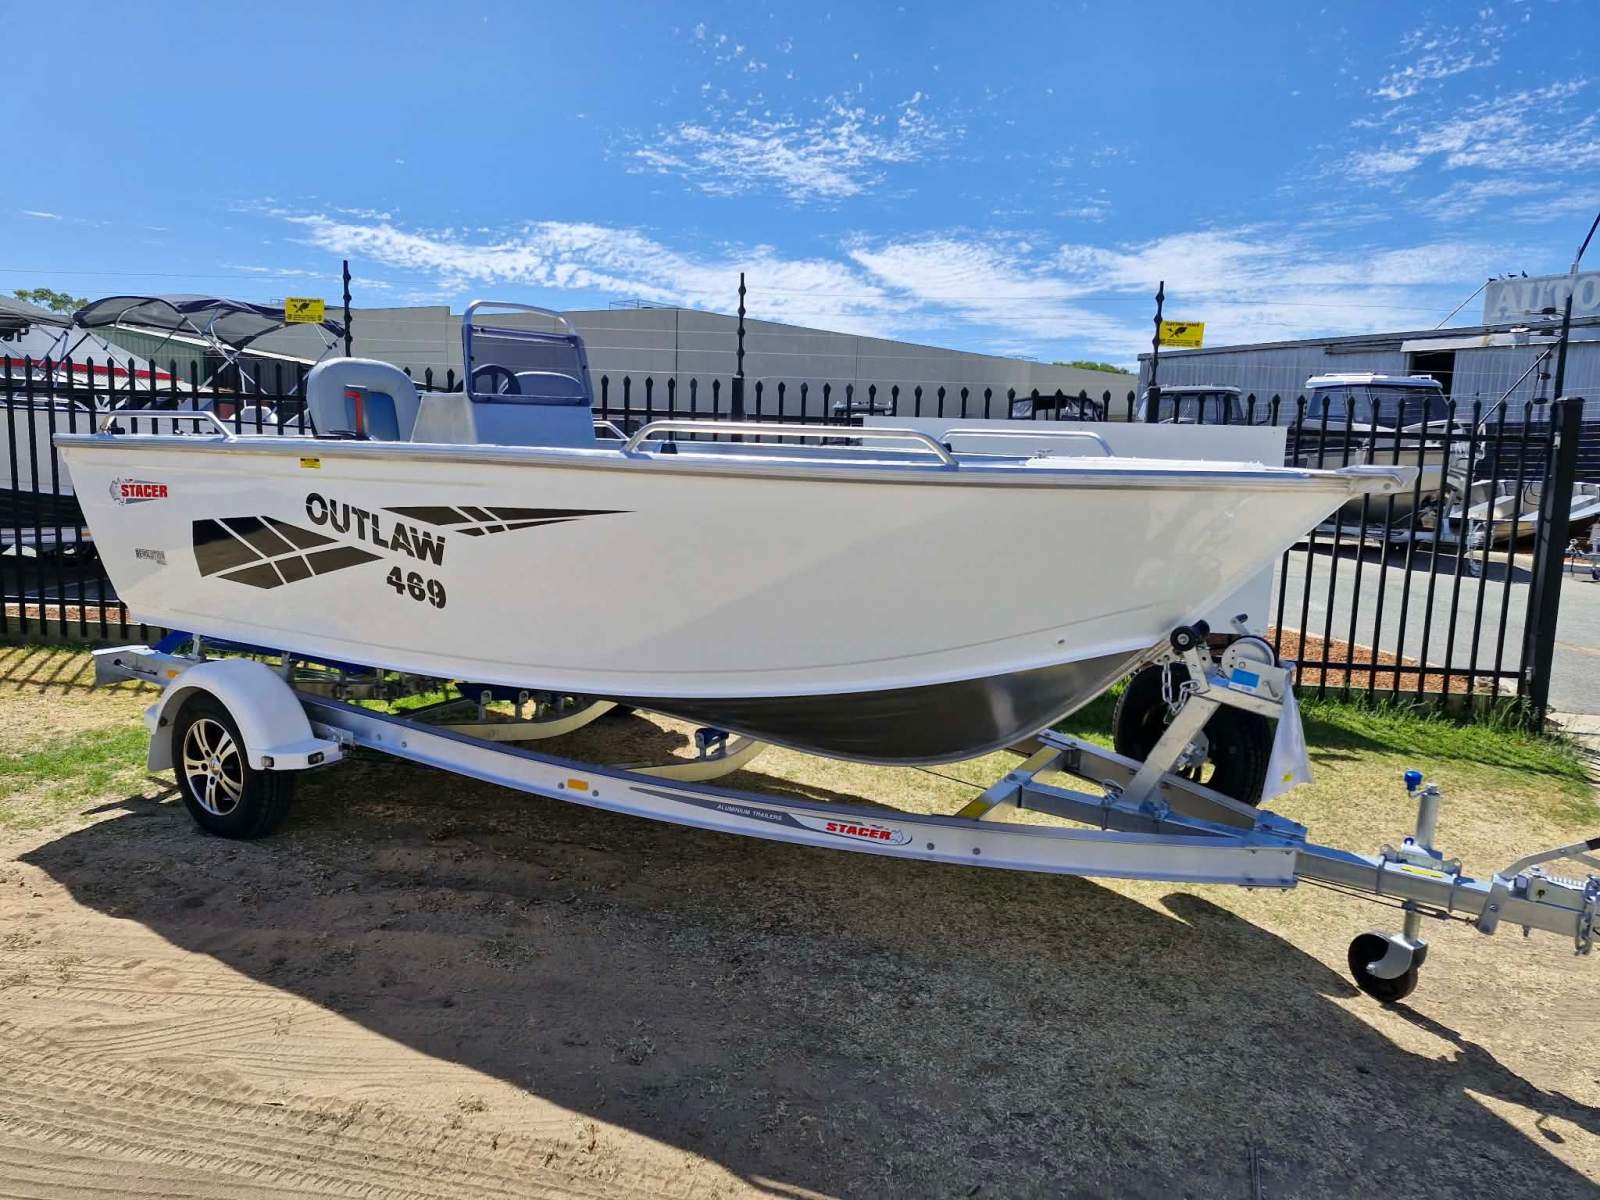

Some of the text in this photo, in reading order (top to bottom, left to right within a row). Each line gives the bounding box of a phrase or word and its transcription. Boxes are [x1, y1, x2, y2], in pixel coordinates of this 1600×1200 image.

[1493, 275, 1600, 314] AUTO
[121, 484, 168, 498] STACER
[305, 492, 446, 566] OUTLAW
[386, 566, 447, 609] 469
[752, 810, 783, 821] TRAILERS
[825, 821, 892, 841] STACER
